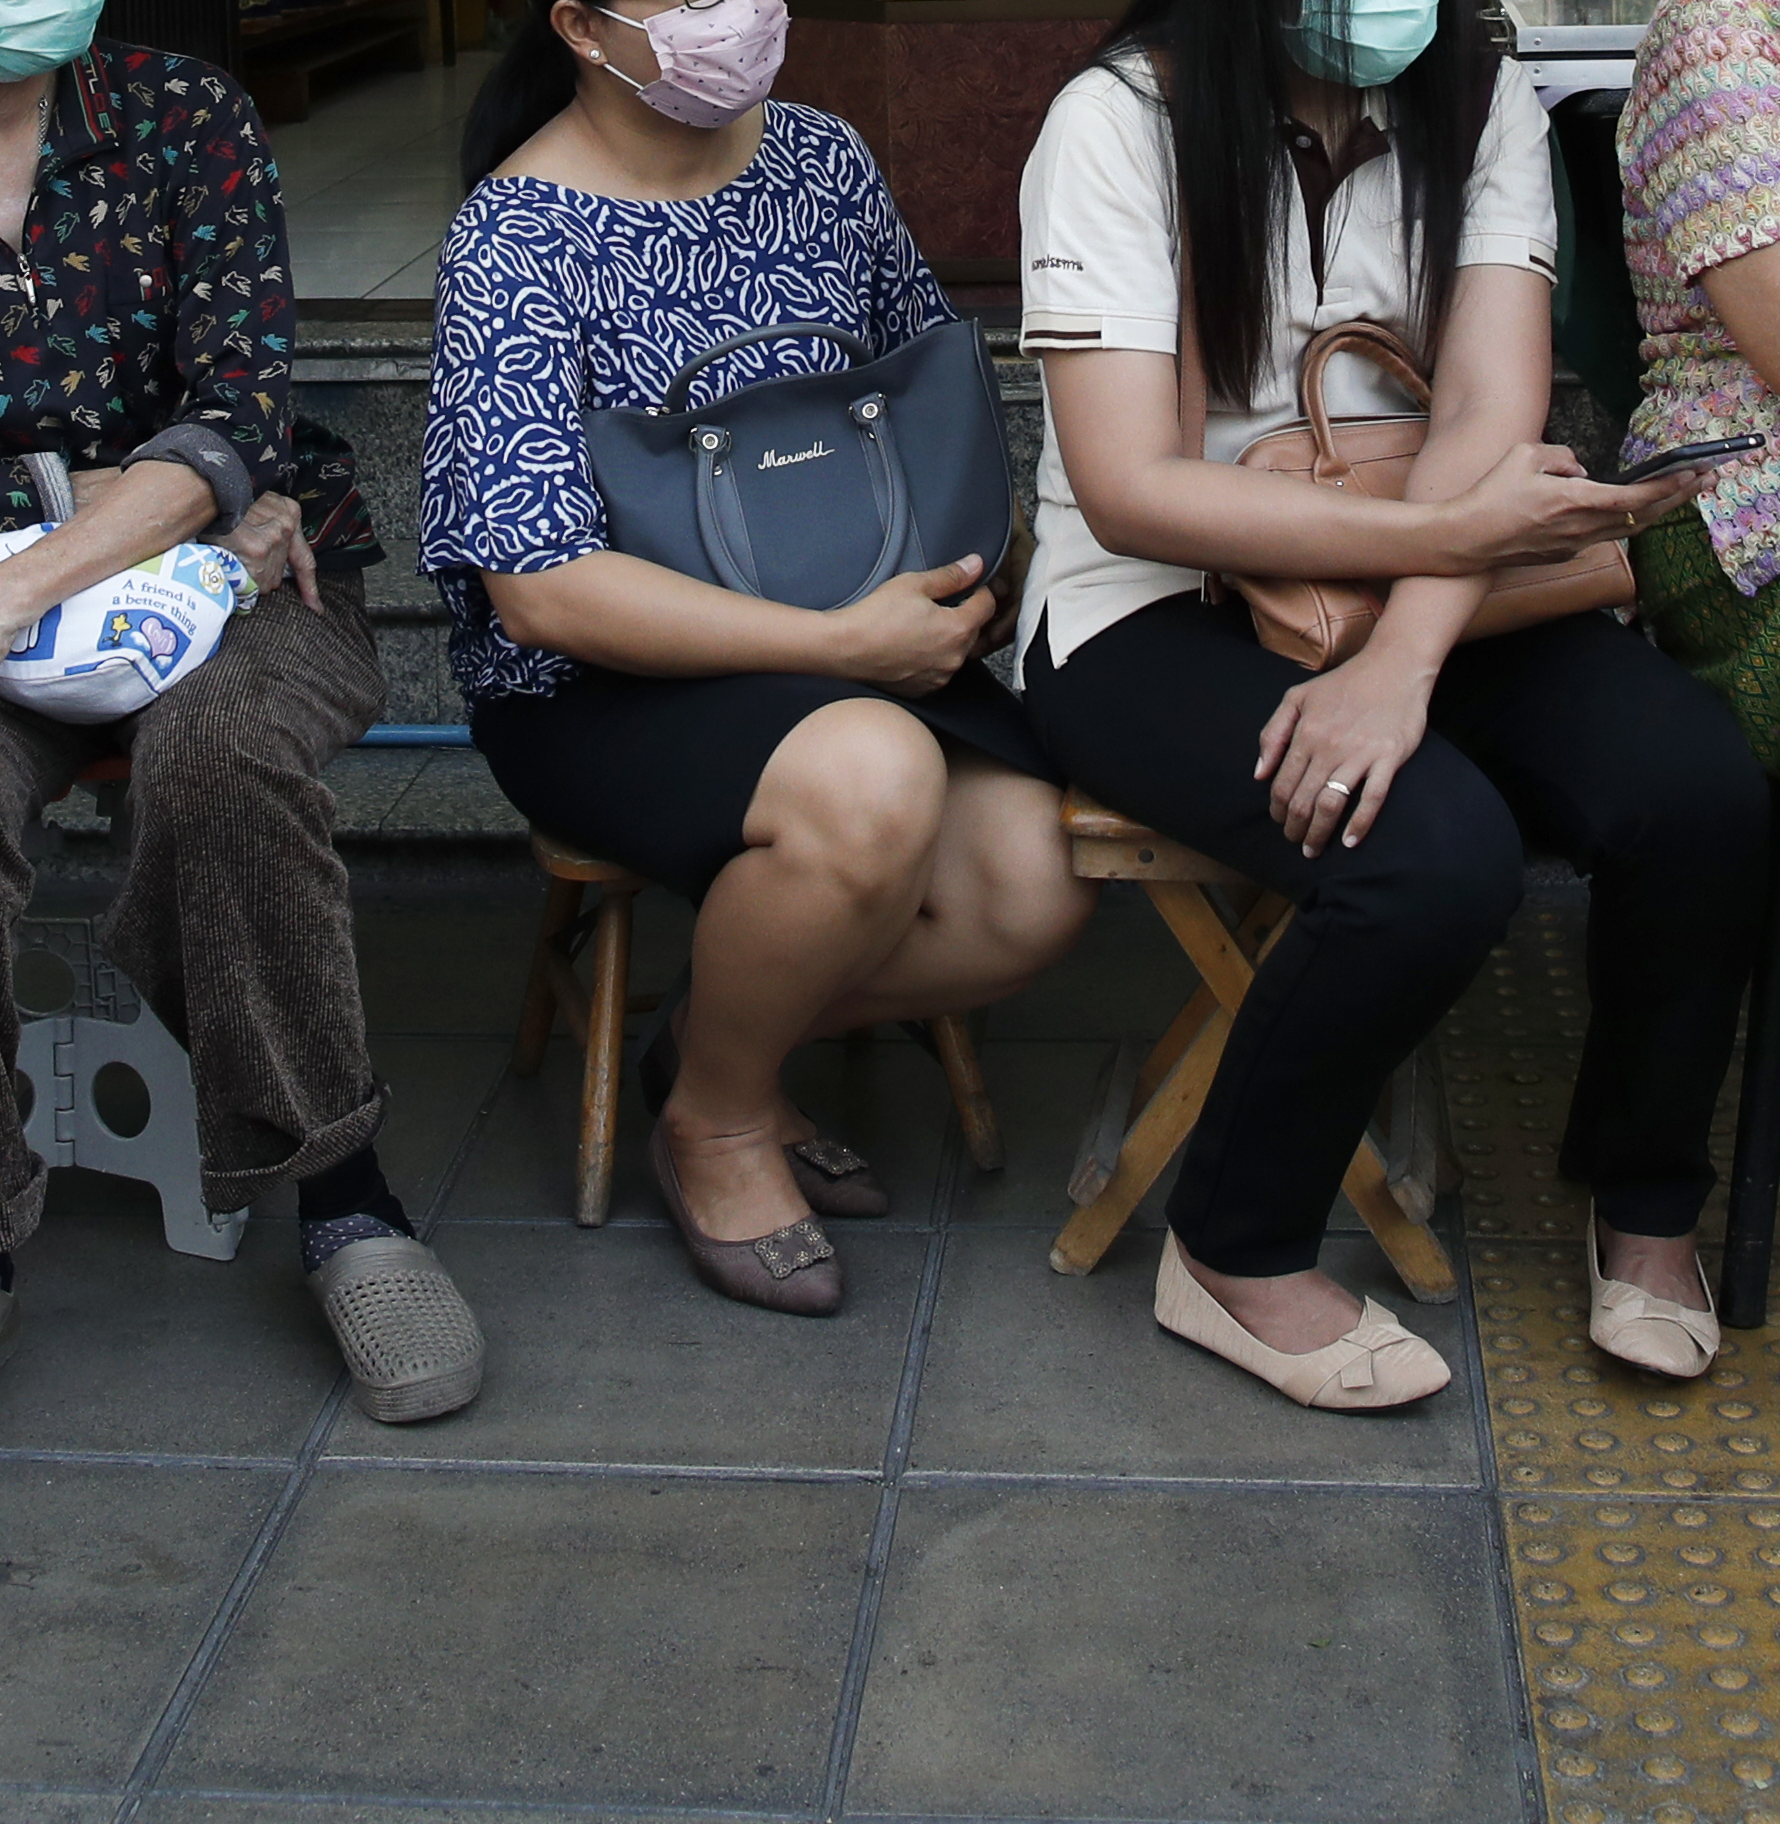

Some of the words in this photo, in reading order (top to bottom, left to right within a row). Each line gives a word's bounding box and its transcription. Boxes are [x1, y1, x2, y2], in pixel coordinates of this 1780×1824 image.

[757, 441, 836, 470] Marwell
[123, 579, 134, 590] A
[141, 581, 183, 602] friend
[187, 595, 197, 610] is
[112, 596, 120, 605] a
[126, 595, 167, 610] better
[171, 605, 197, 636] thing
